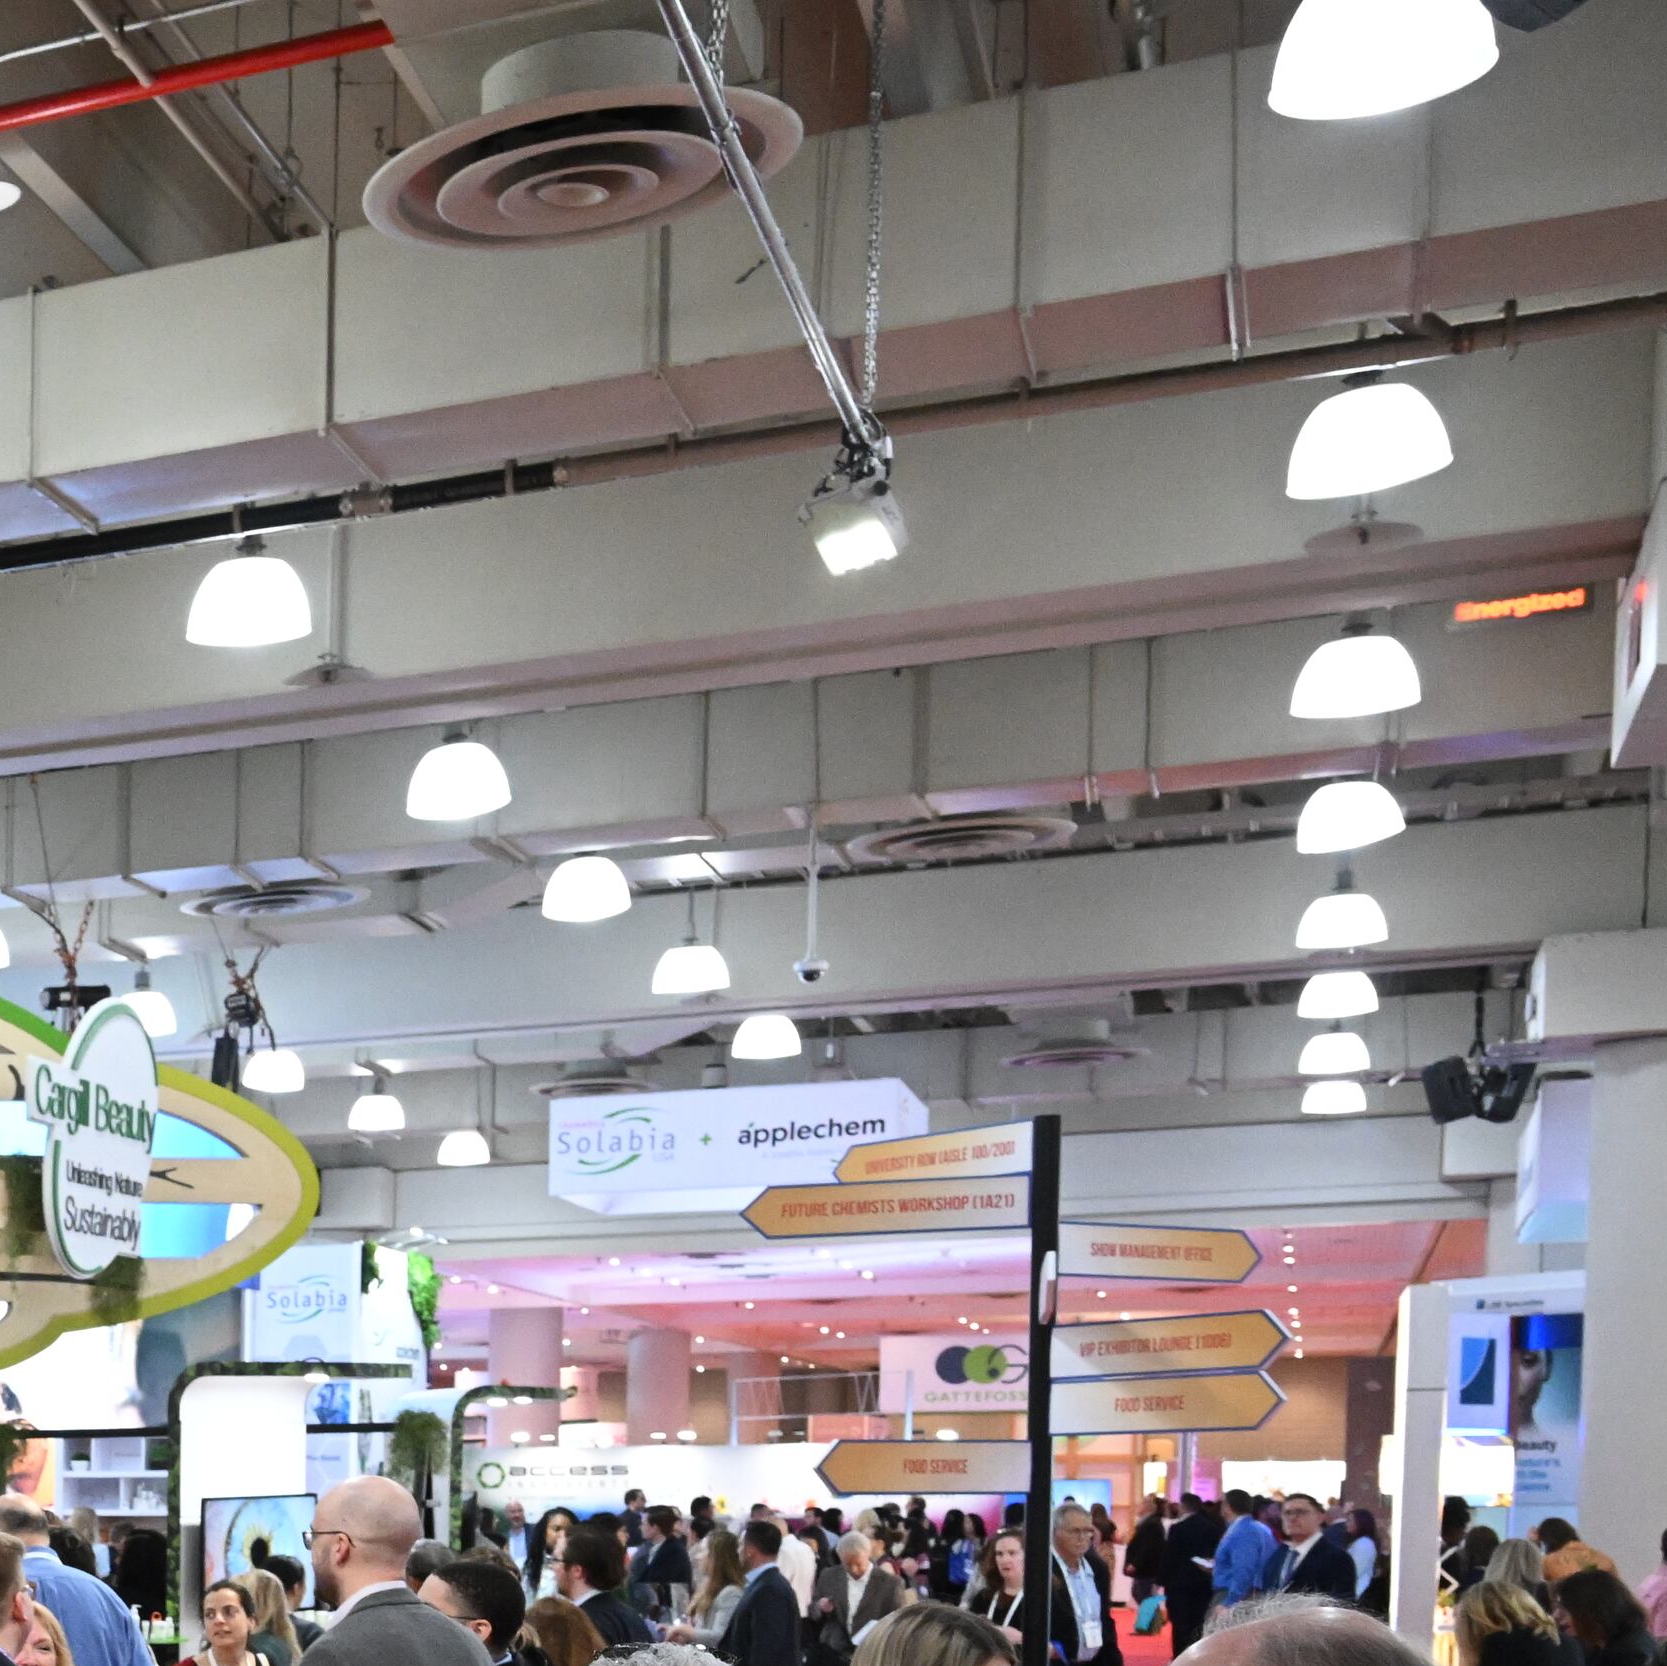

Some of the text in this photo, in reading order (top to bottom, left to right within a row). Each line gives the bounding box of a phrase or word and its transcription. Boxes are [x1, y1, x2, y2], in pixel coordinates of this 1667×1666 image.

[35, 1063, 153, 1155] Cargill Beauty
[556, 1126, 676, 1155] Solabia
[781, 1193, 1016, 1218] FUTURE CHEMISTS WORKSHOP (1A21)
[64, 1195, 141, 1252] Sustainably
[1090, 1242, 1214, 1262] SHOW MANAGEMENT OFFICE
[266, 1289, 348, 1309] Solabia
[1079, 1342, 1097, 1357] VIP
[924, 1390, 1029, 1403] GATTEFOSS
[1114, 1395, 1185, 1412] FOOD SERVICE
[902, 1458, 969, 1475] FOOD SERVICE
